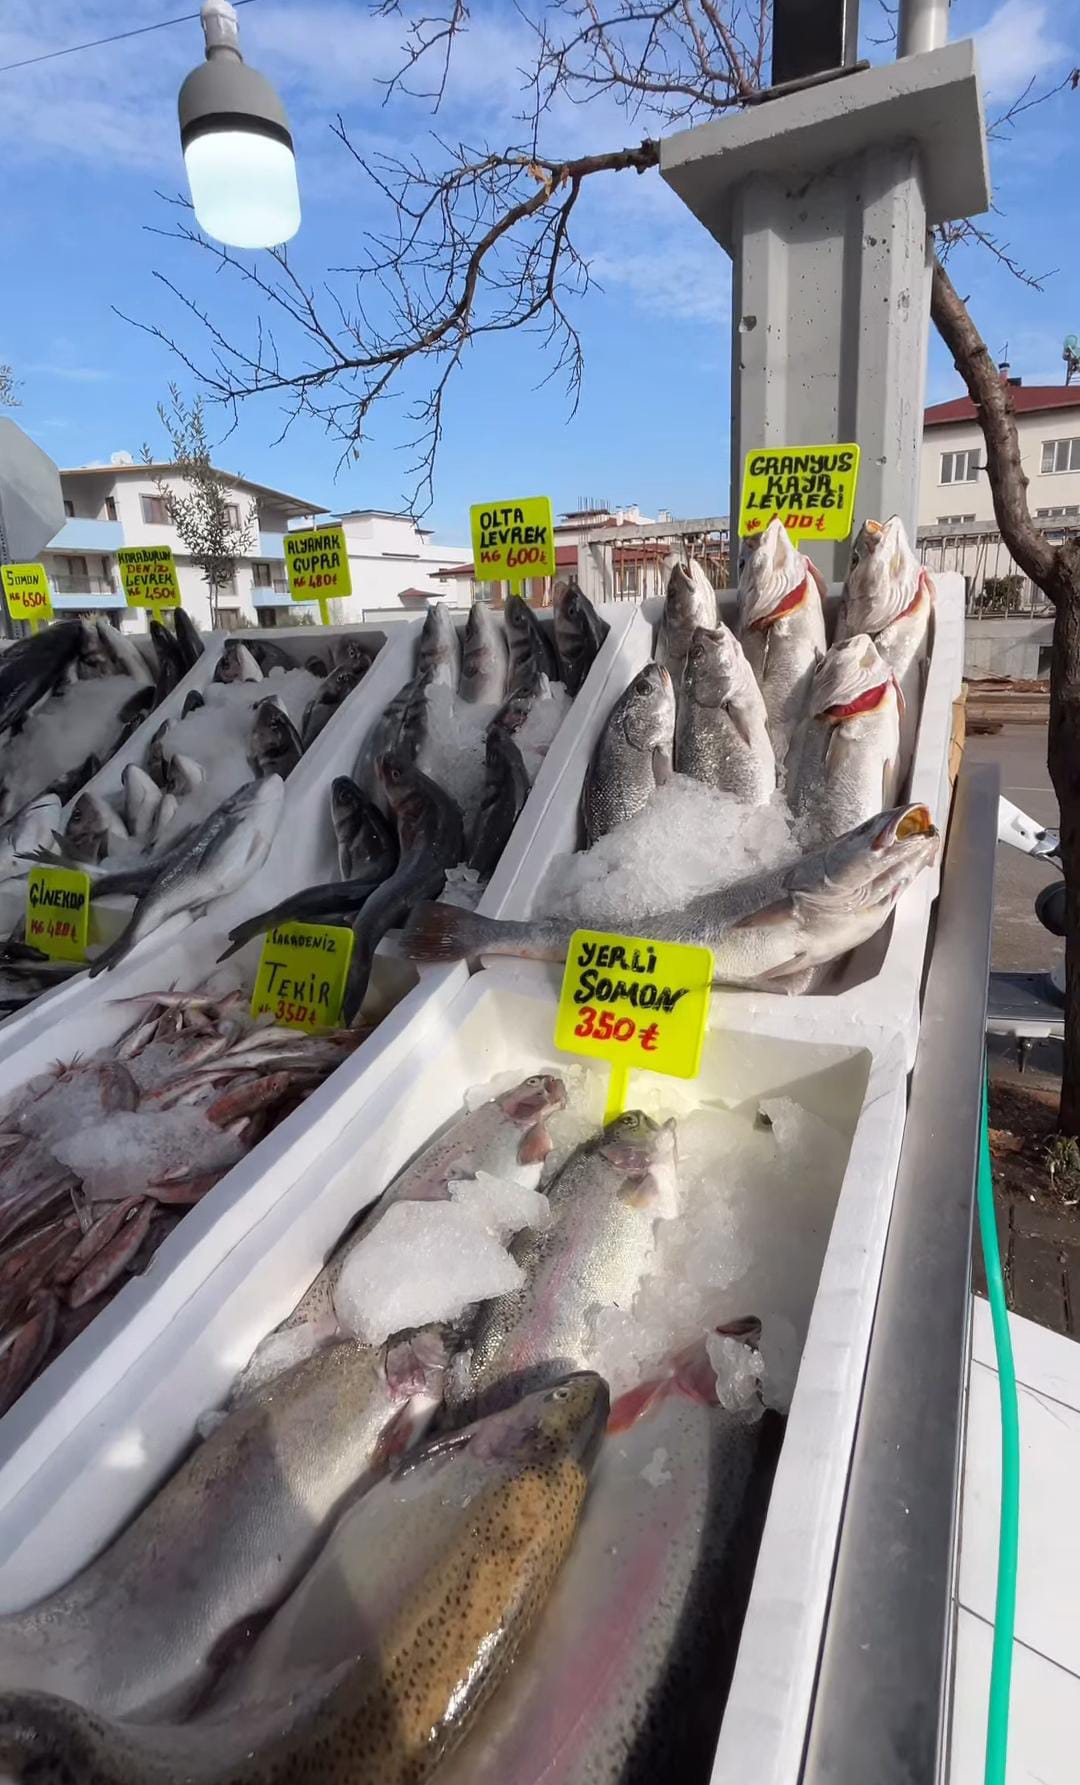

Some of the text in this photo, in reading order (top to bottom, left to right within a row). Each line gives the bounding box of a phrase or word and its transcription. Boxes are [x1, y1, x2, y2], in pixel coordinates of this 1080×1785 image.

[750, 452, 853, 476] GRANYUS
[767, 474, 831, 494] KAYA
[480, 508, 524, 530] OLTA
[767, 512, 825, 531] 00₺
[288, 535, 341, 554] ALYANAK
[480, 526, 547, 548] LEVREK
[481, 550, 501, 563] KG
[126, 573, 174, 587] LEVREK
[577, 942, 657, 973] YERLİ
[264, 961, 330, 1007] TEKİR
[573, 969, 690, 1013] SOMON
